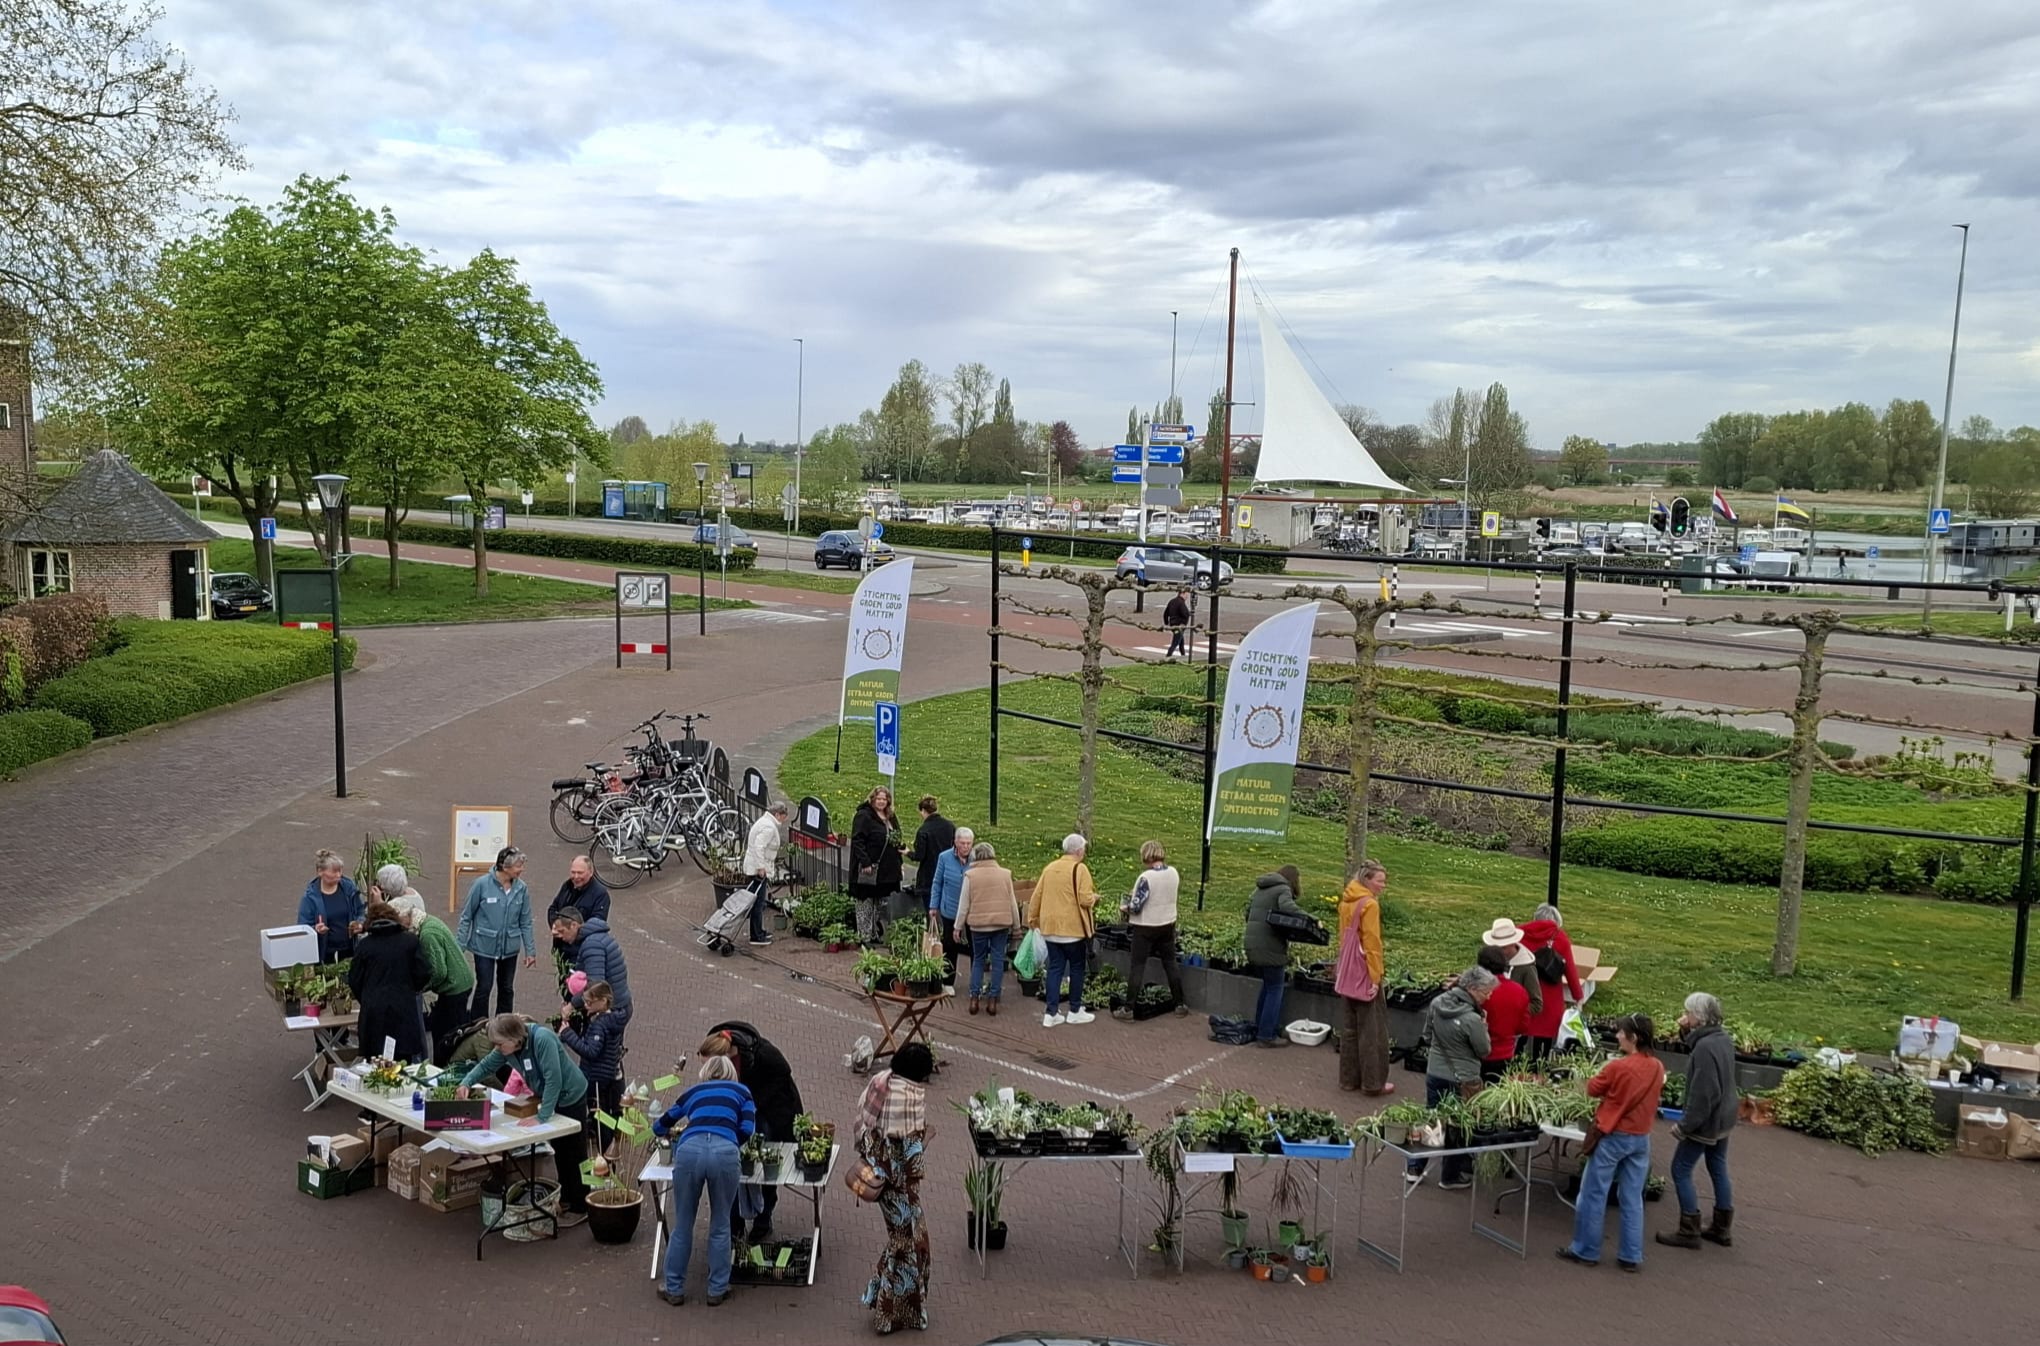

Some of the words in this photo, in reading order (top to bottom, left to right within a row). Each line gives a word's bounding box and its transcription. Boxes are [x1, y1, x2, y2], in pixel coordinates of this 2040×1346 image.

[864, 590, 901, 600] STICHTING
[860, 599, 882, 609] GROEN
[866, 609, 894, 619] HATTEM
[1246, 650, 1298, 665] STICHTING
[1241, 662, 1273, 676] GROEN
[1277, 667, 1299, 679] GOUD
[1249, 676, 1287, 691] HATTEM
[880, 706, 893, 734] P
[1236, 778, 1271, 789] NATUUR
[1220, 790, 1255, 802] EETBAAR
[1258, 793, 1286, 804] GROEN
[1223, 804, 1279, 816] ONTMOETING
